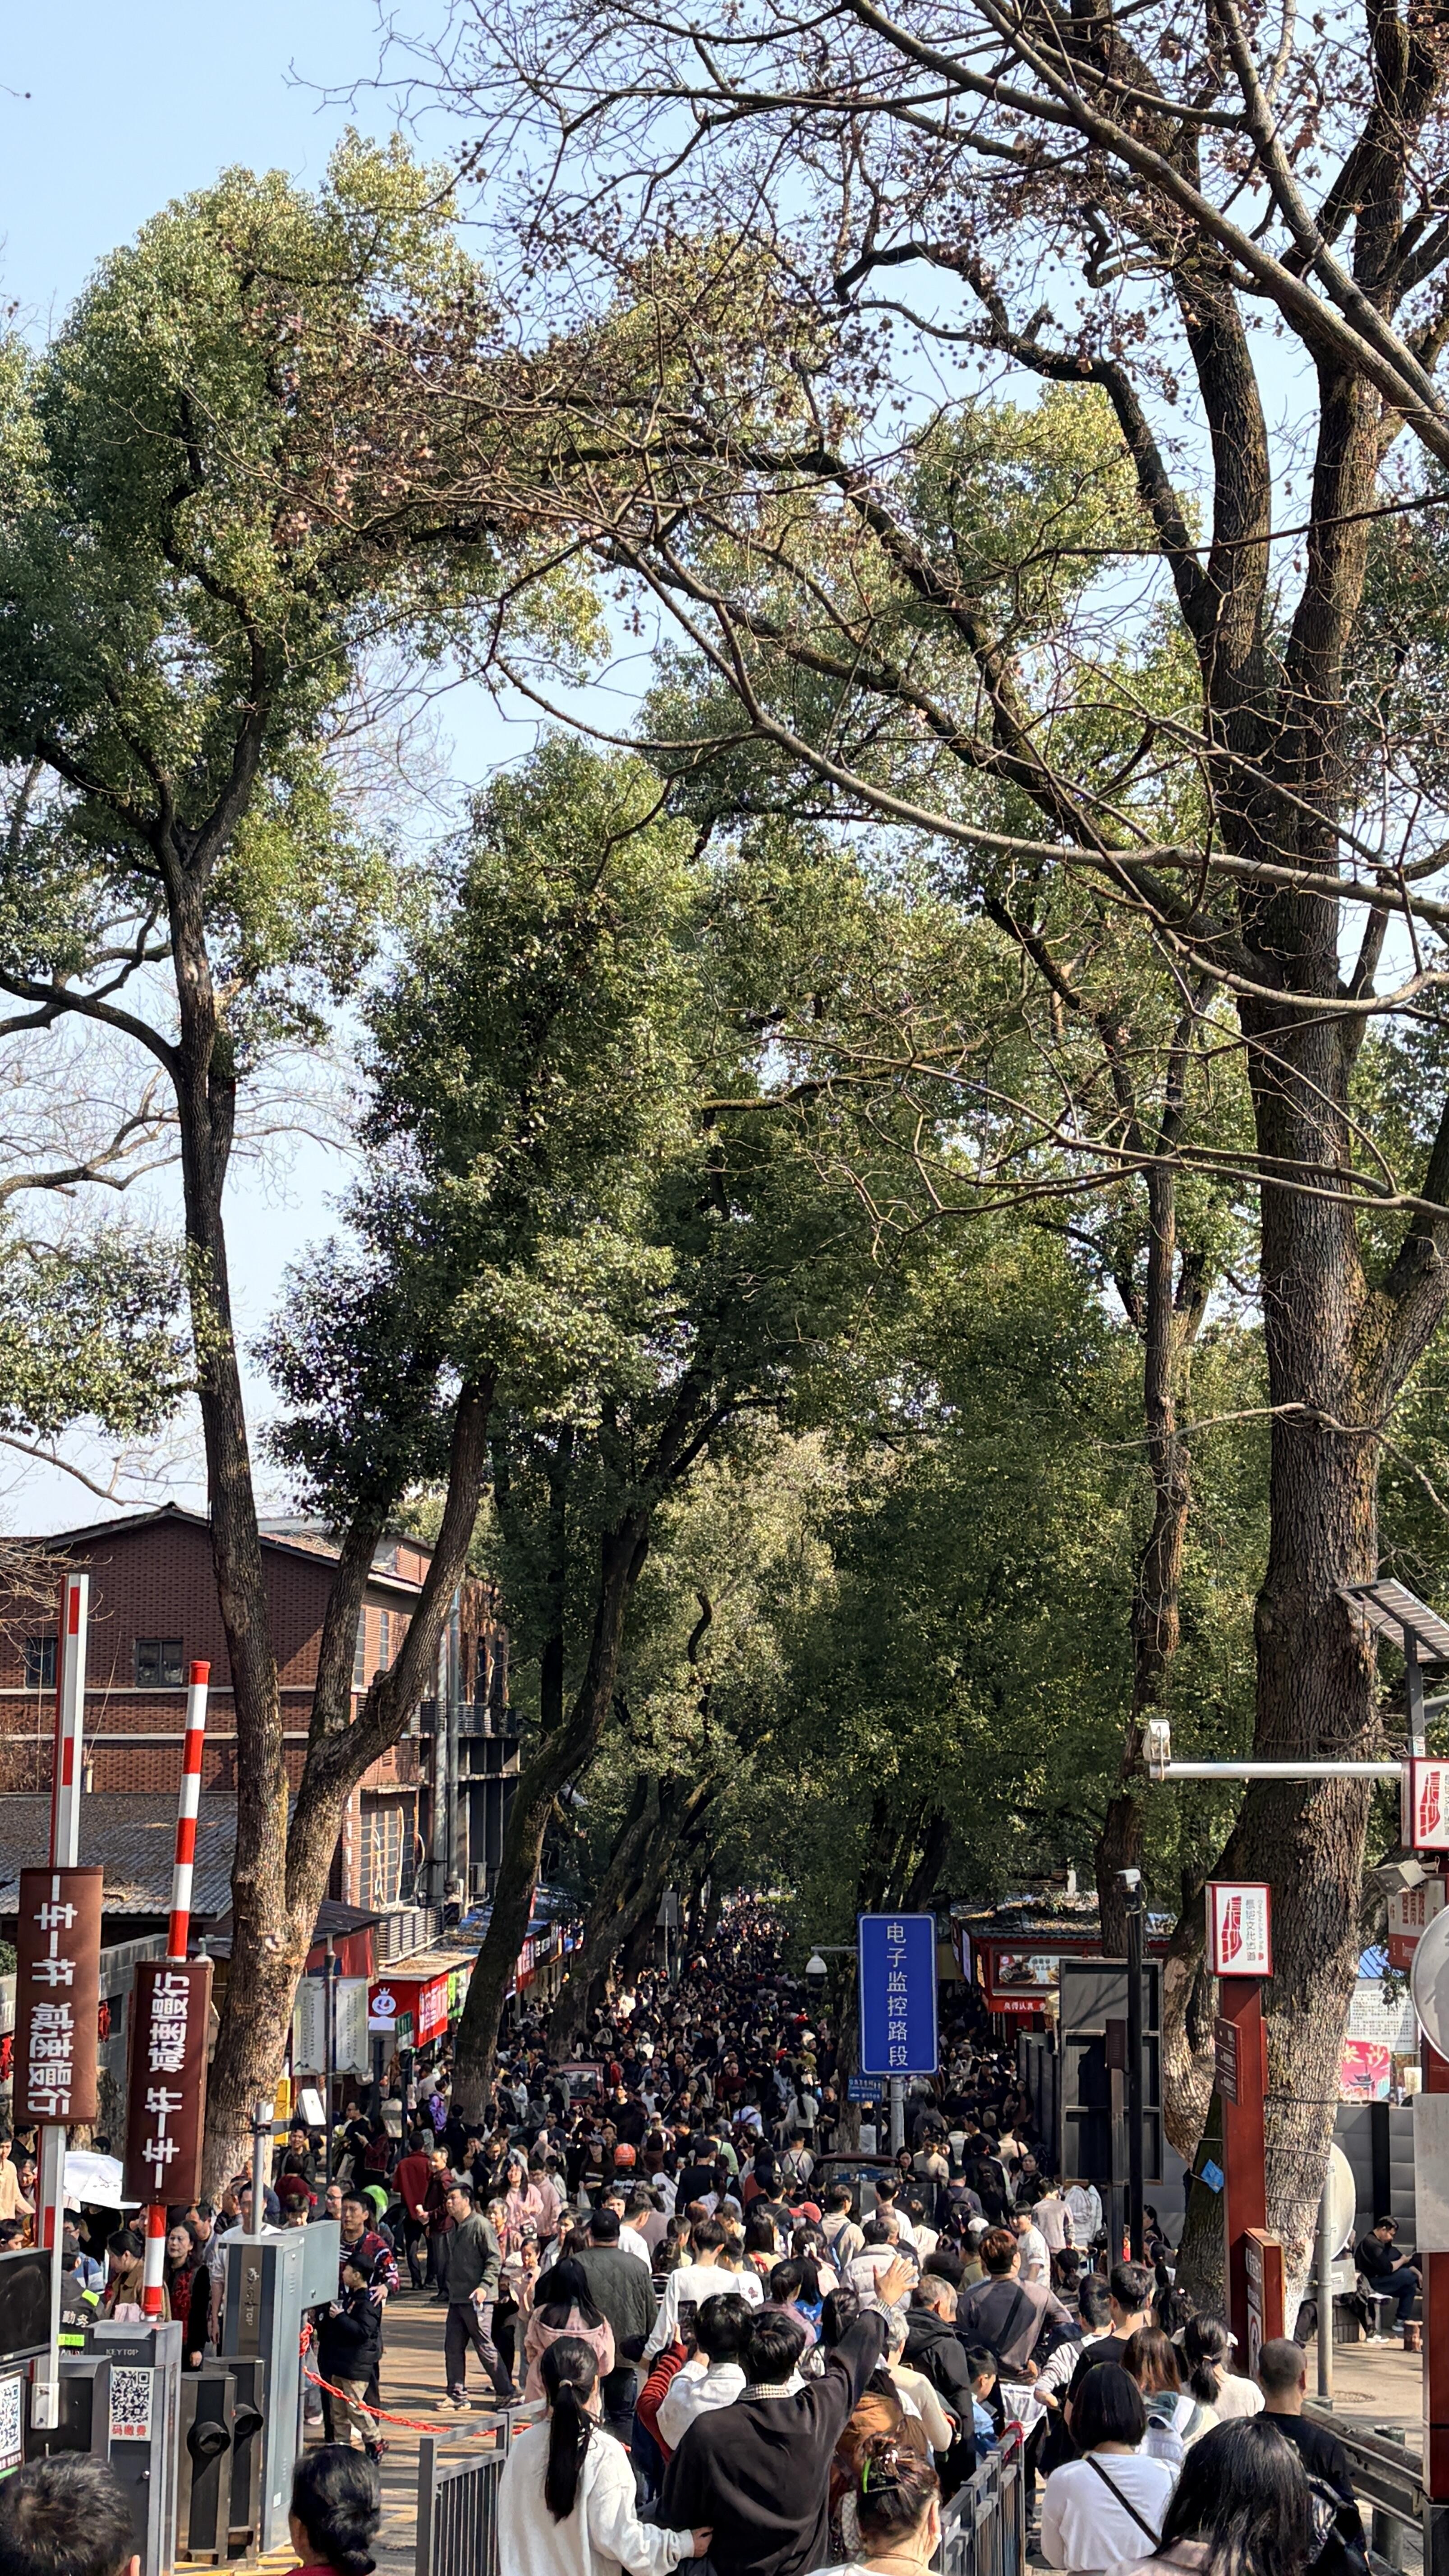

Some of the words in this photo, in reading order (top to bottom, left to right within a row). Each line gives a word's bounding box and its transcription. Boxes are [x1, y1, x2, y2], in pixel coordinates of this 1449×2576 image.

[32, 1875, 78, 1987] 一车一杆
[148, 1972, 191, 2073] 减速慢行
[887, 1922, 908, 2067] 电子监控路段
[27, 2002, 74, 2116] 减速慢行
[142, 2087, 183, 2189] 一车一杆
[106, 2348, 139, 2357] KEYTOP
